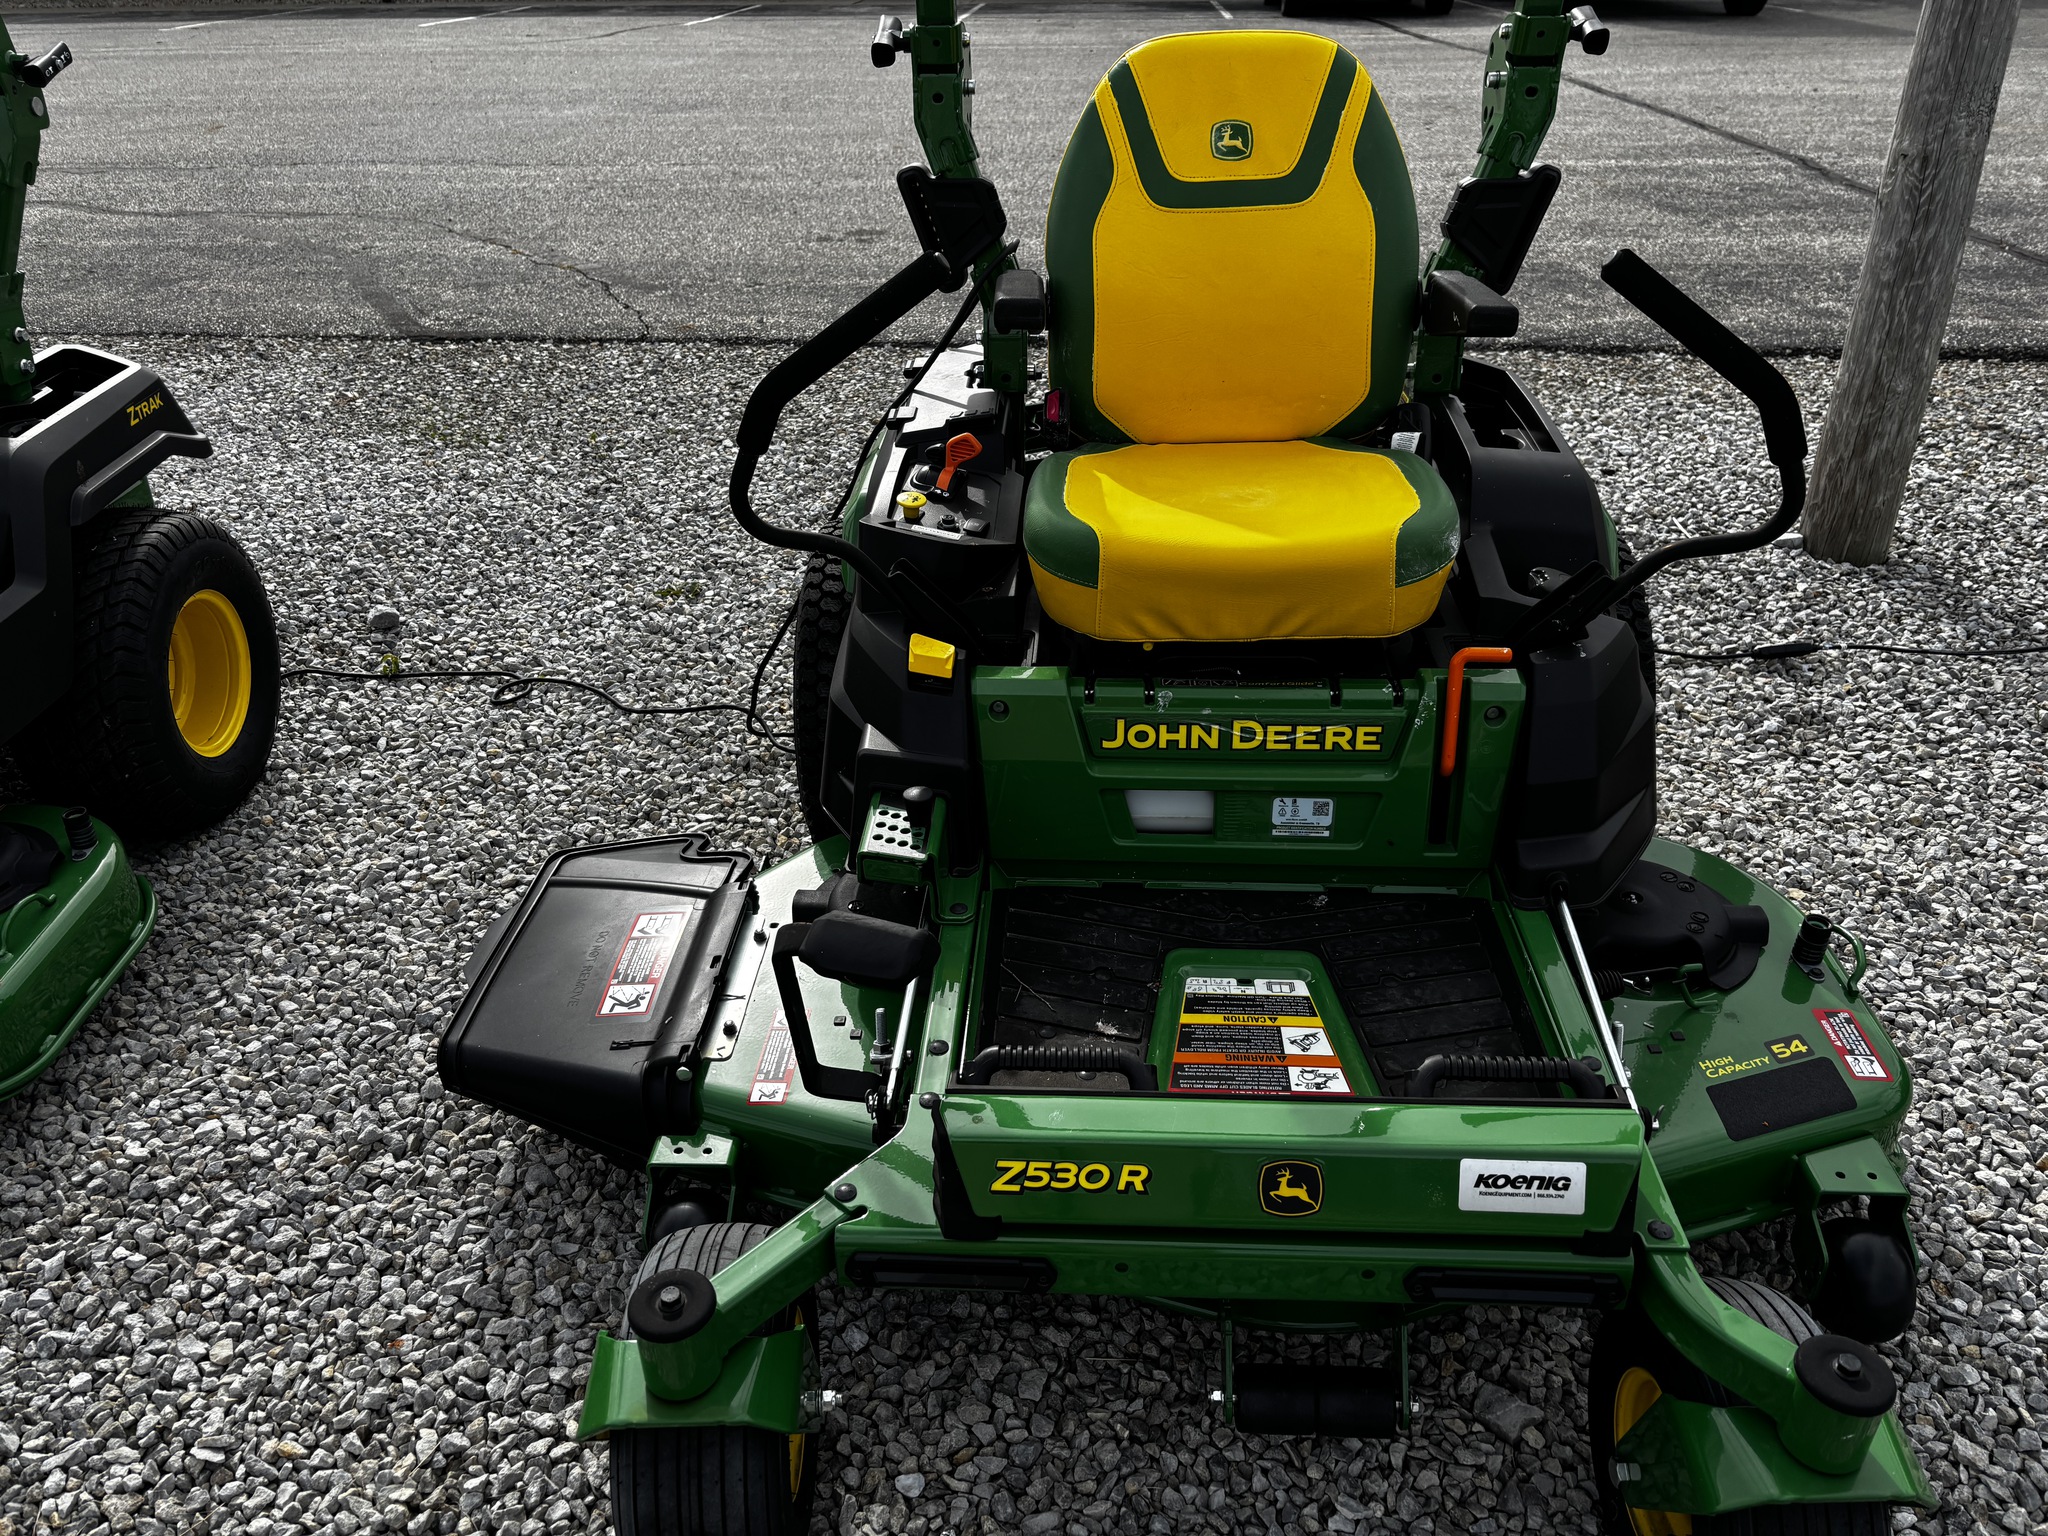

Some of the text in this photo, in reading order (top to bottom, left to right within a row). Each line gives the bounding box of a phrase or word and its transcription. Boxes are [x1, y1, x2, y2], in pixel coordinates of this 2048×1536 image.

[126, 392, 164, 426] ZTRAK
[1101, 718, 1384, 751] JOHN DEERE
[586, 944, 604, 963] NOT
[567, 965, 594, 1008] REMOVE
[1820, 1020, 1838, 1041] DANGER
[1225, 1054, 1276, 1062] WARNING
[1770, 1040, 1808, 1058] 54
[1698, 1056, 1734, 1070] HIGH
[1706, 1056, 1770, 1078] CAPACITY
[990, 1160, 1152, 1195] Z530 R
